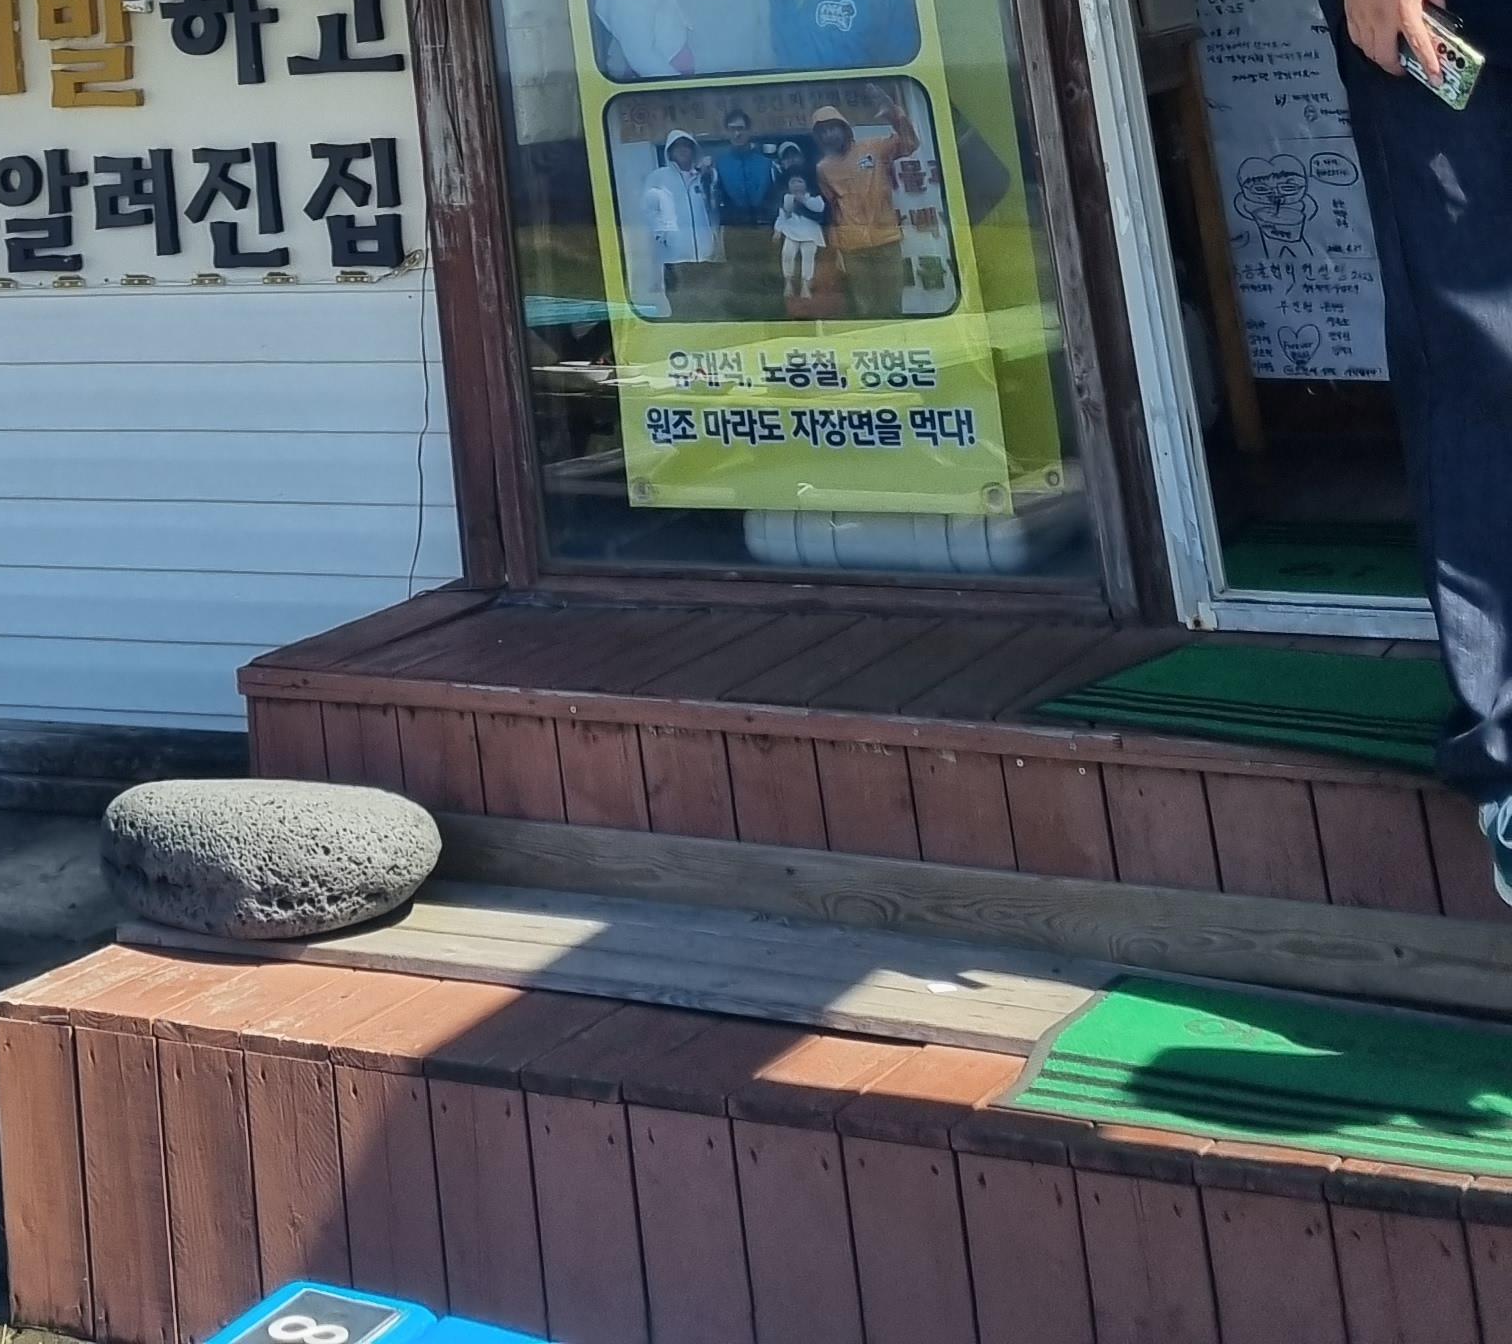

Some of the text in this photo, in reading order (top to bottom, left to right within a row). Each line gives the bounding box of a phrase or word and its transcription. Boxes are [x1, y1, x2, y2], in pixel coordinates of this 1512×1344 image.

[646, 407, 976, 447] 원조 마라도 자장면을 먹다!
[268, 1315, 349, 1344] 8
